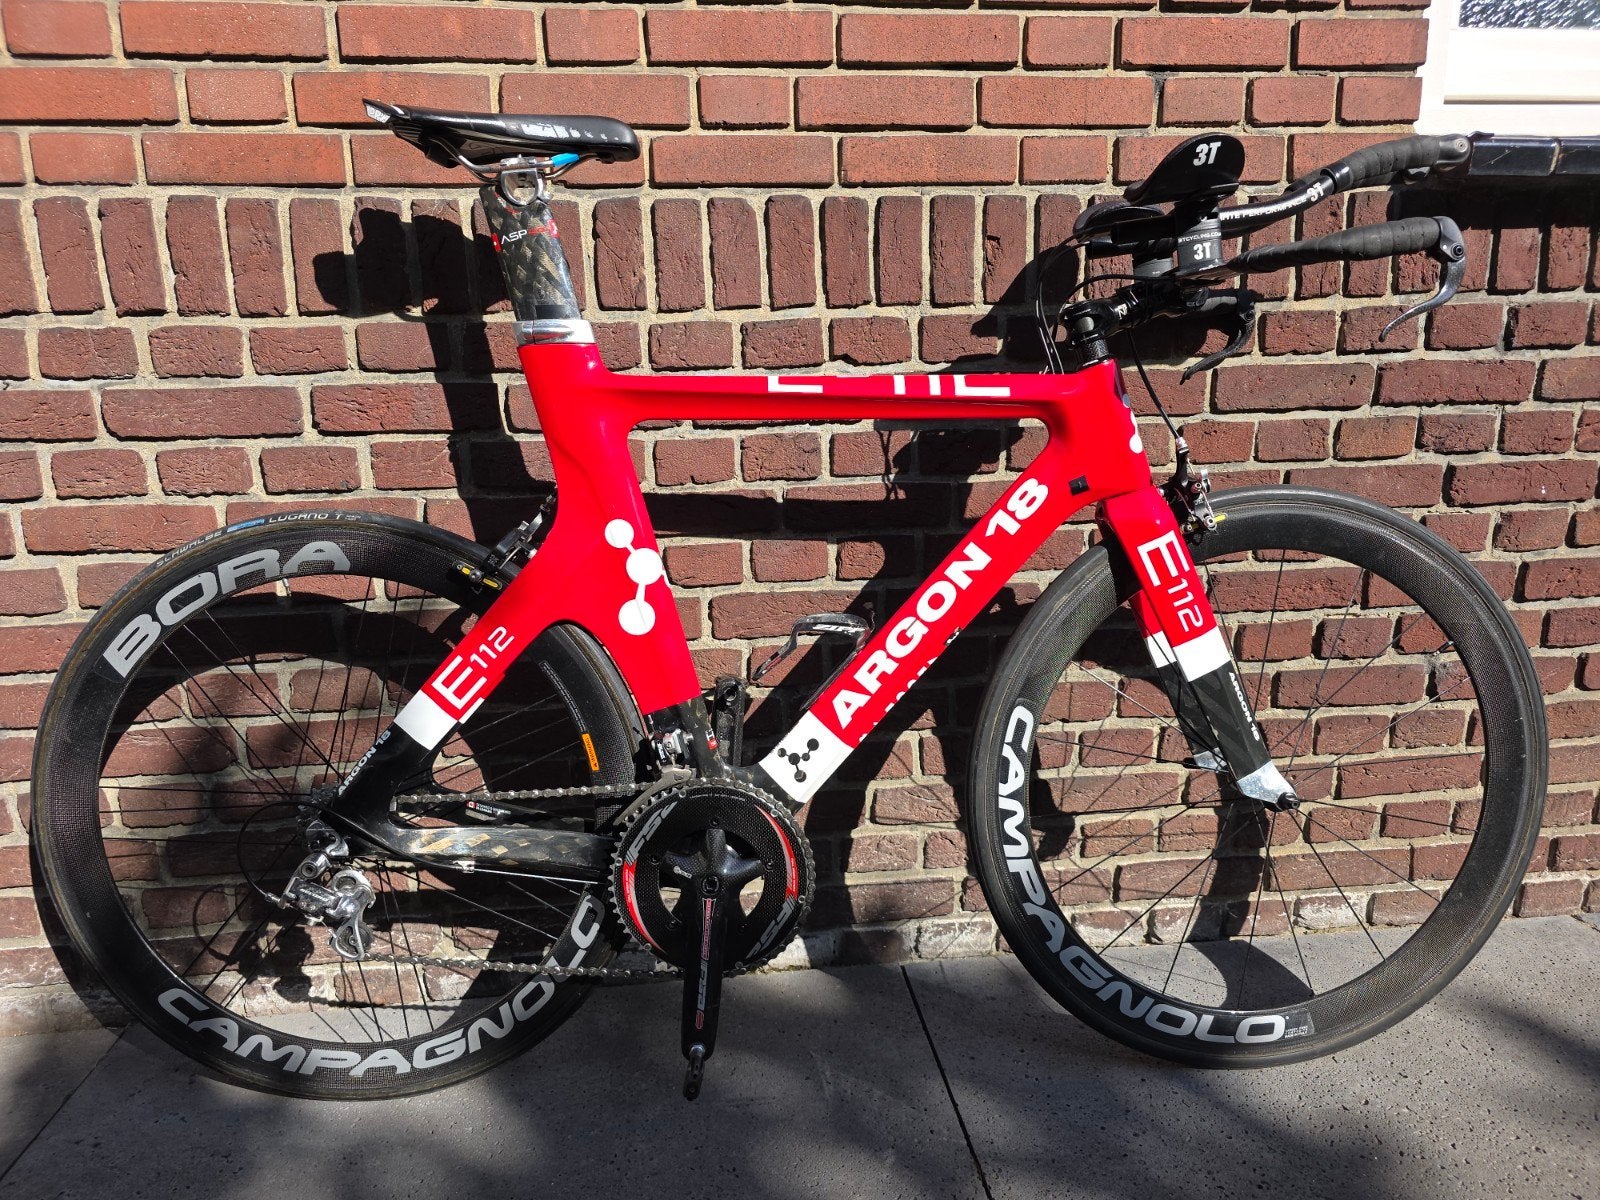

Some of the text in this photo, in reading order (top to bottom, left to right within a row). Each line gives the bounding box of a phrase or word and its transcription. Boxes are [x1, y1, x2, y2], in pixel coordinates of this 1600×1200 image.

[1193, 141, 1222, 166] 3T
[1306, 181, 1325, 202] 3T
[1193, 242, 1212, 261] 3T
[269, 512, 329, 524] LUGANO
[103, 540, 350, 679] BORA
[832, 541, 993, 730] ARGON
[985, 477, 1049, 536] 18
[1228, 671, 1253, 723] ARGON
[338, 748, 377, 796] ARGON
[998, 705, 1287, 1044] CAMPAGNOLO
